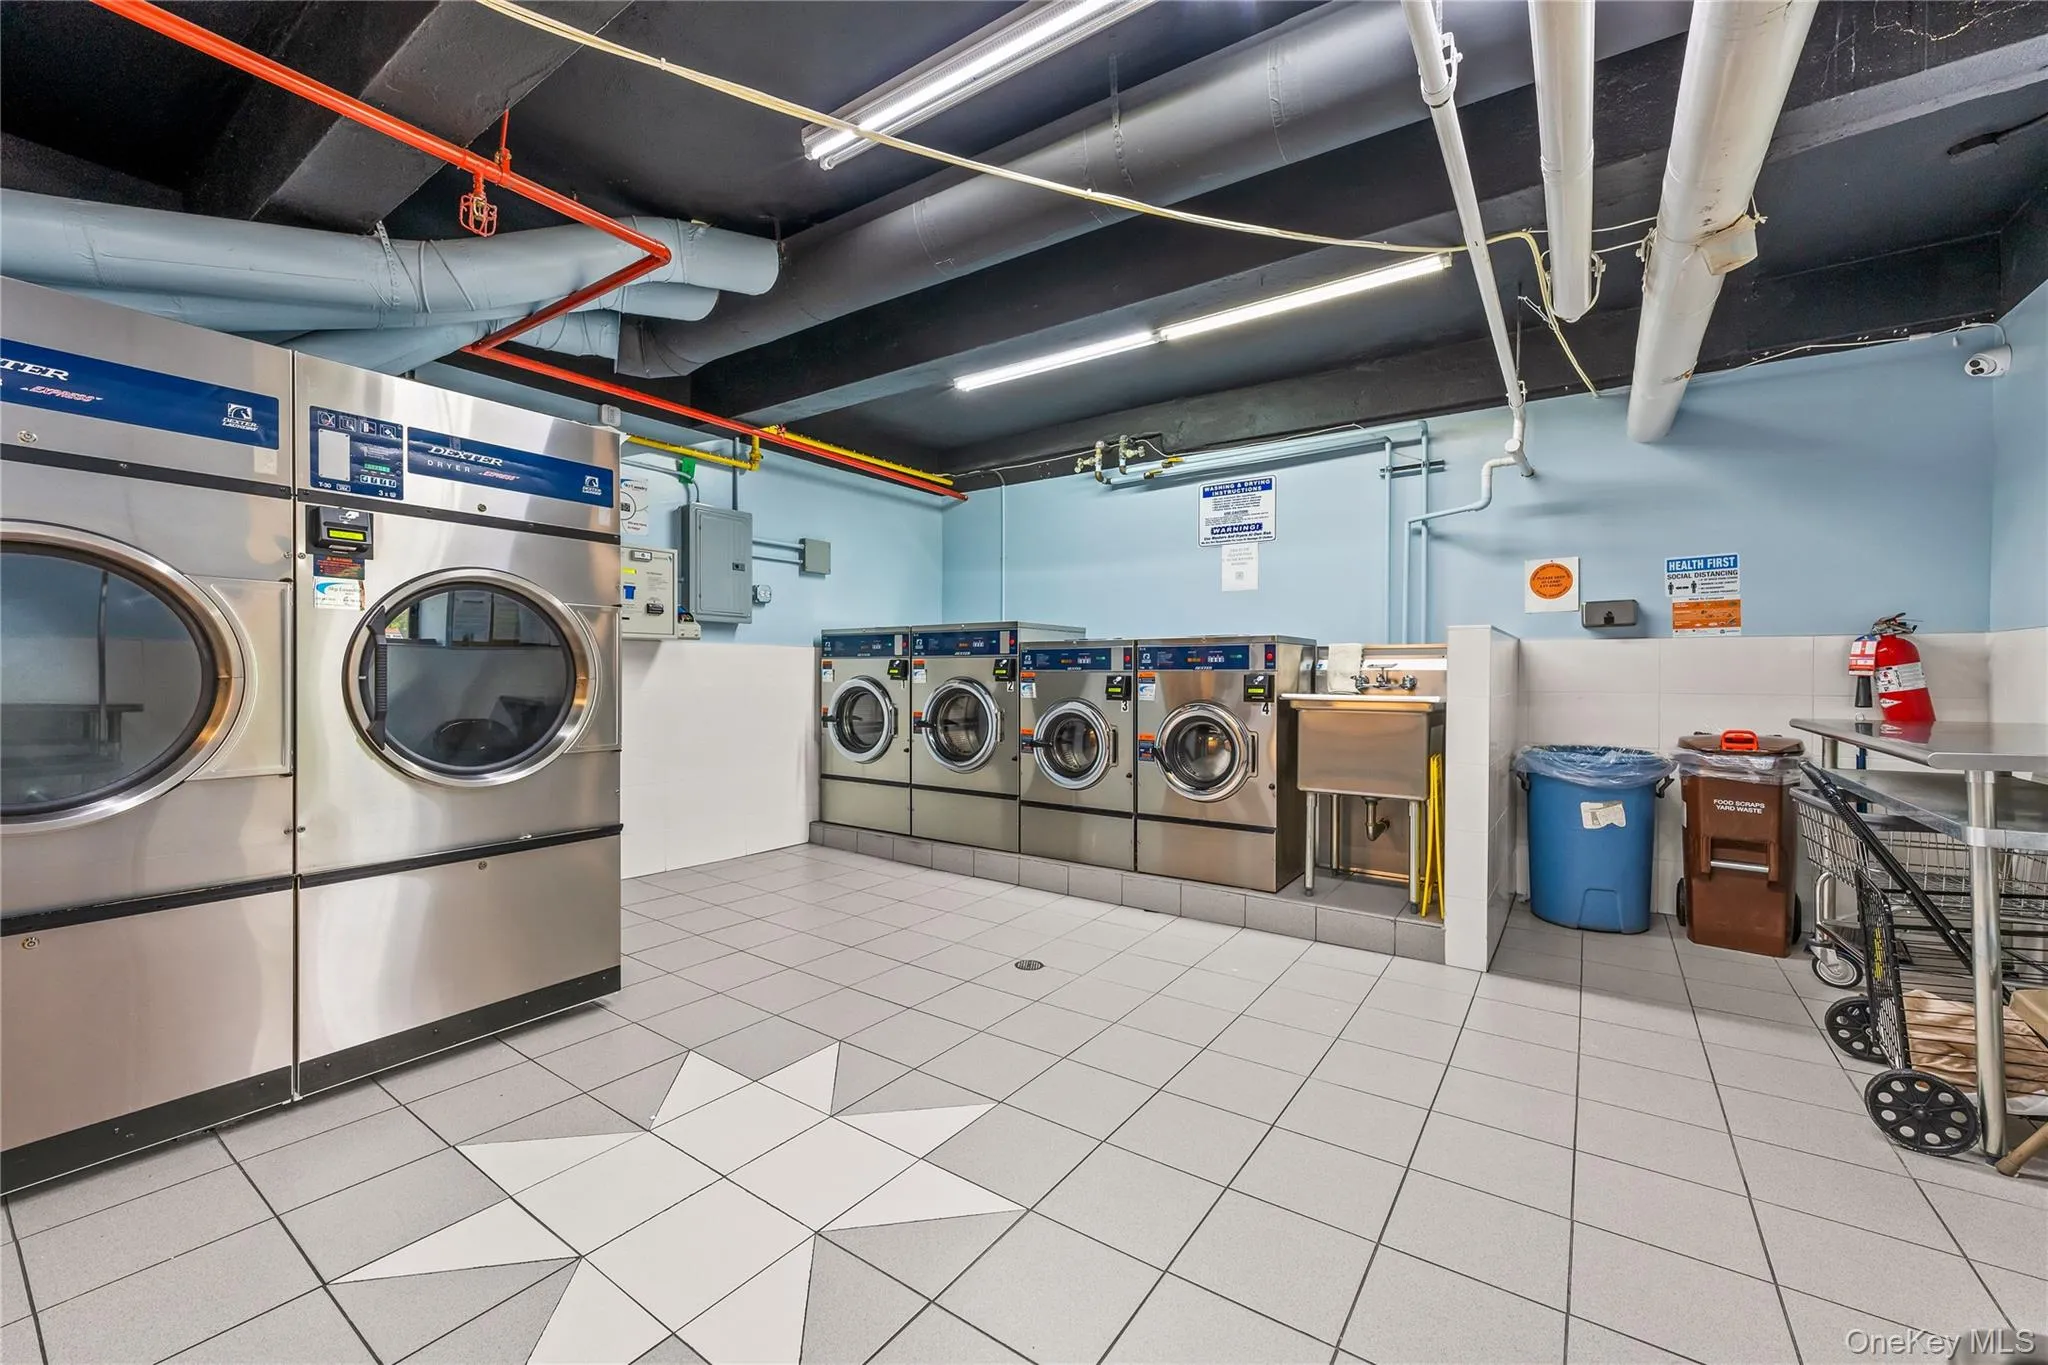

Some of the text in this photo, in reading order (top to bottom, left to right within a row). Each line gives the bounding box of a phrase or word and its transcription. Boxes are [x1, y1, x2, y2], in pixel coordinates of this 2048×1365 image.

[0, 358, 70, 381] TER
[428, 445, 503, 467] DEXTER
[427, 459, 471, 473] DRYER
[1204, 483, 1235, 492] WASHING
[1244, 479, 1271, 487] DRYING
[1211, 486, 1262, 496] INSTRUCTIONS
[1212, 524, 1260, 534] WARNING!
[1669, 556, 1736, 571] HEALTH FIRST
[1667, 572, 1693, 580] SOCIAL
[1694, 569, 1739, 578] DISTANCING
[1007, 681, 1014, 691] 2
[1122, 700, 1129, 711] 3
[1262, 703, 1270, 715] 4
[1735, 800, 1766, 809] SCRAPS
[1736, 806, 1763, 814] WASTE
